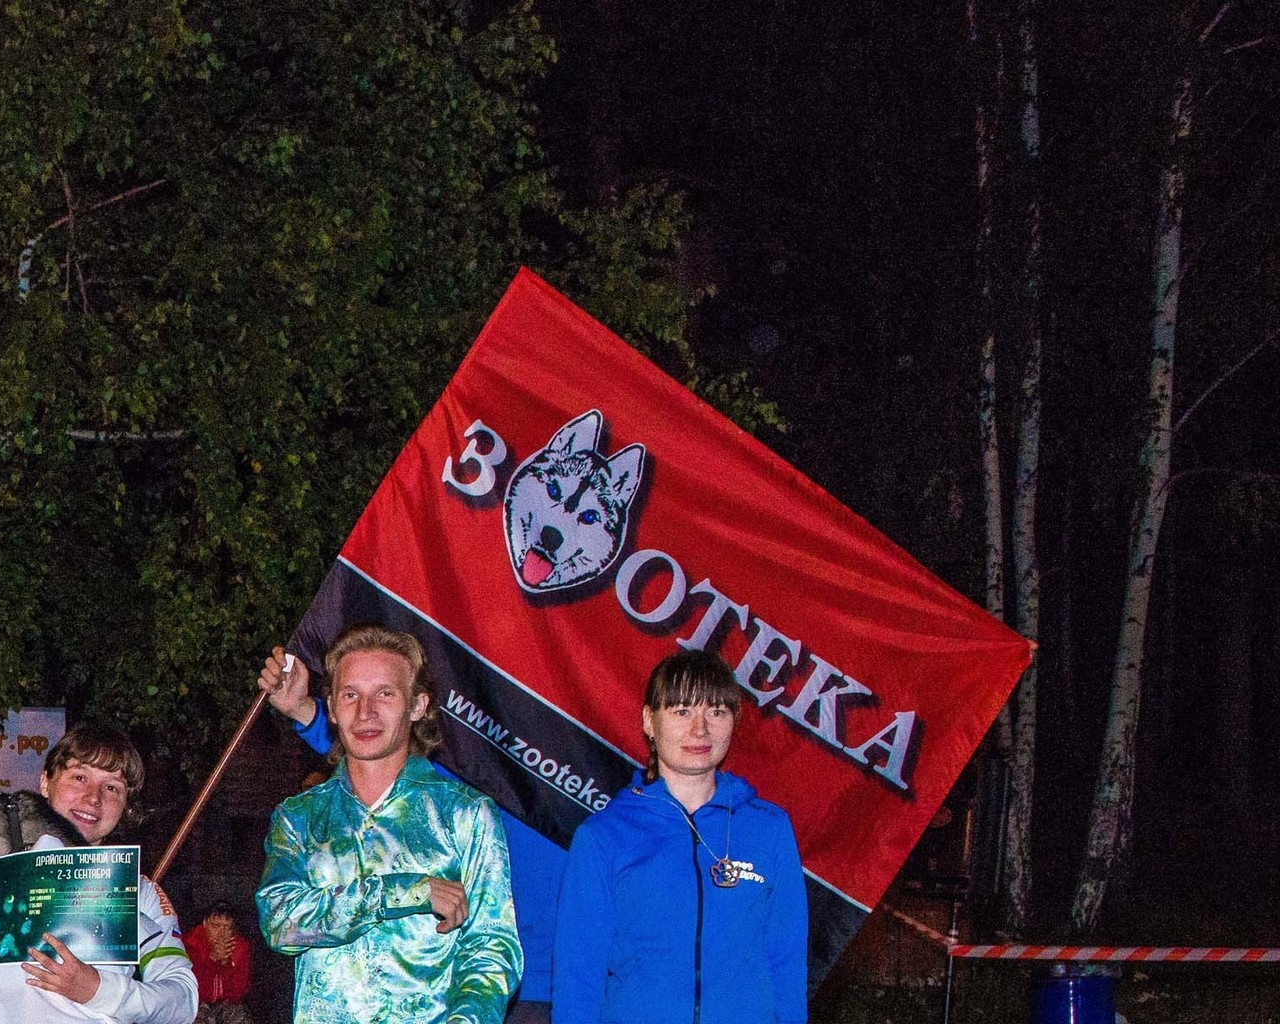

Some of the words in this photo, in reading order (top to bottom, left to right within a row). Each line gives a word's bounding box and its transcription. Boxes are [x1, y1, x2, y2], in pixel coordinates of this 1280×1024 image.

[615, 549, 916, 790] ОТЕКА
[446, 689, 611, 812] www.zooteka
[35, 853, 74, 867] ДРАЙЛЕНД
[57, 869, 71, 880] 2-3
[74, 868, 111, 879] СЕНТЯБРЯ
